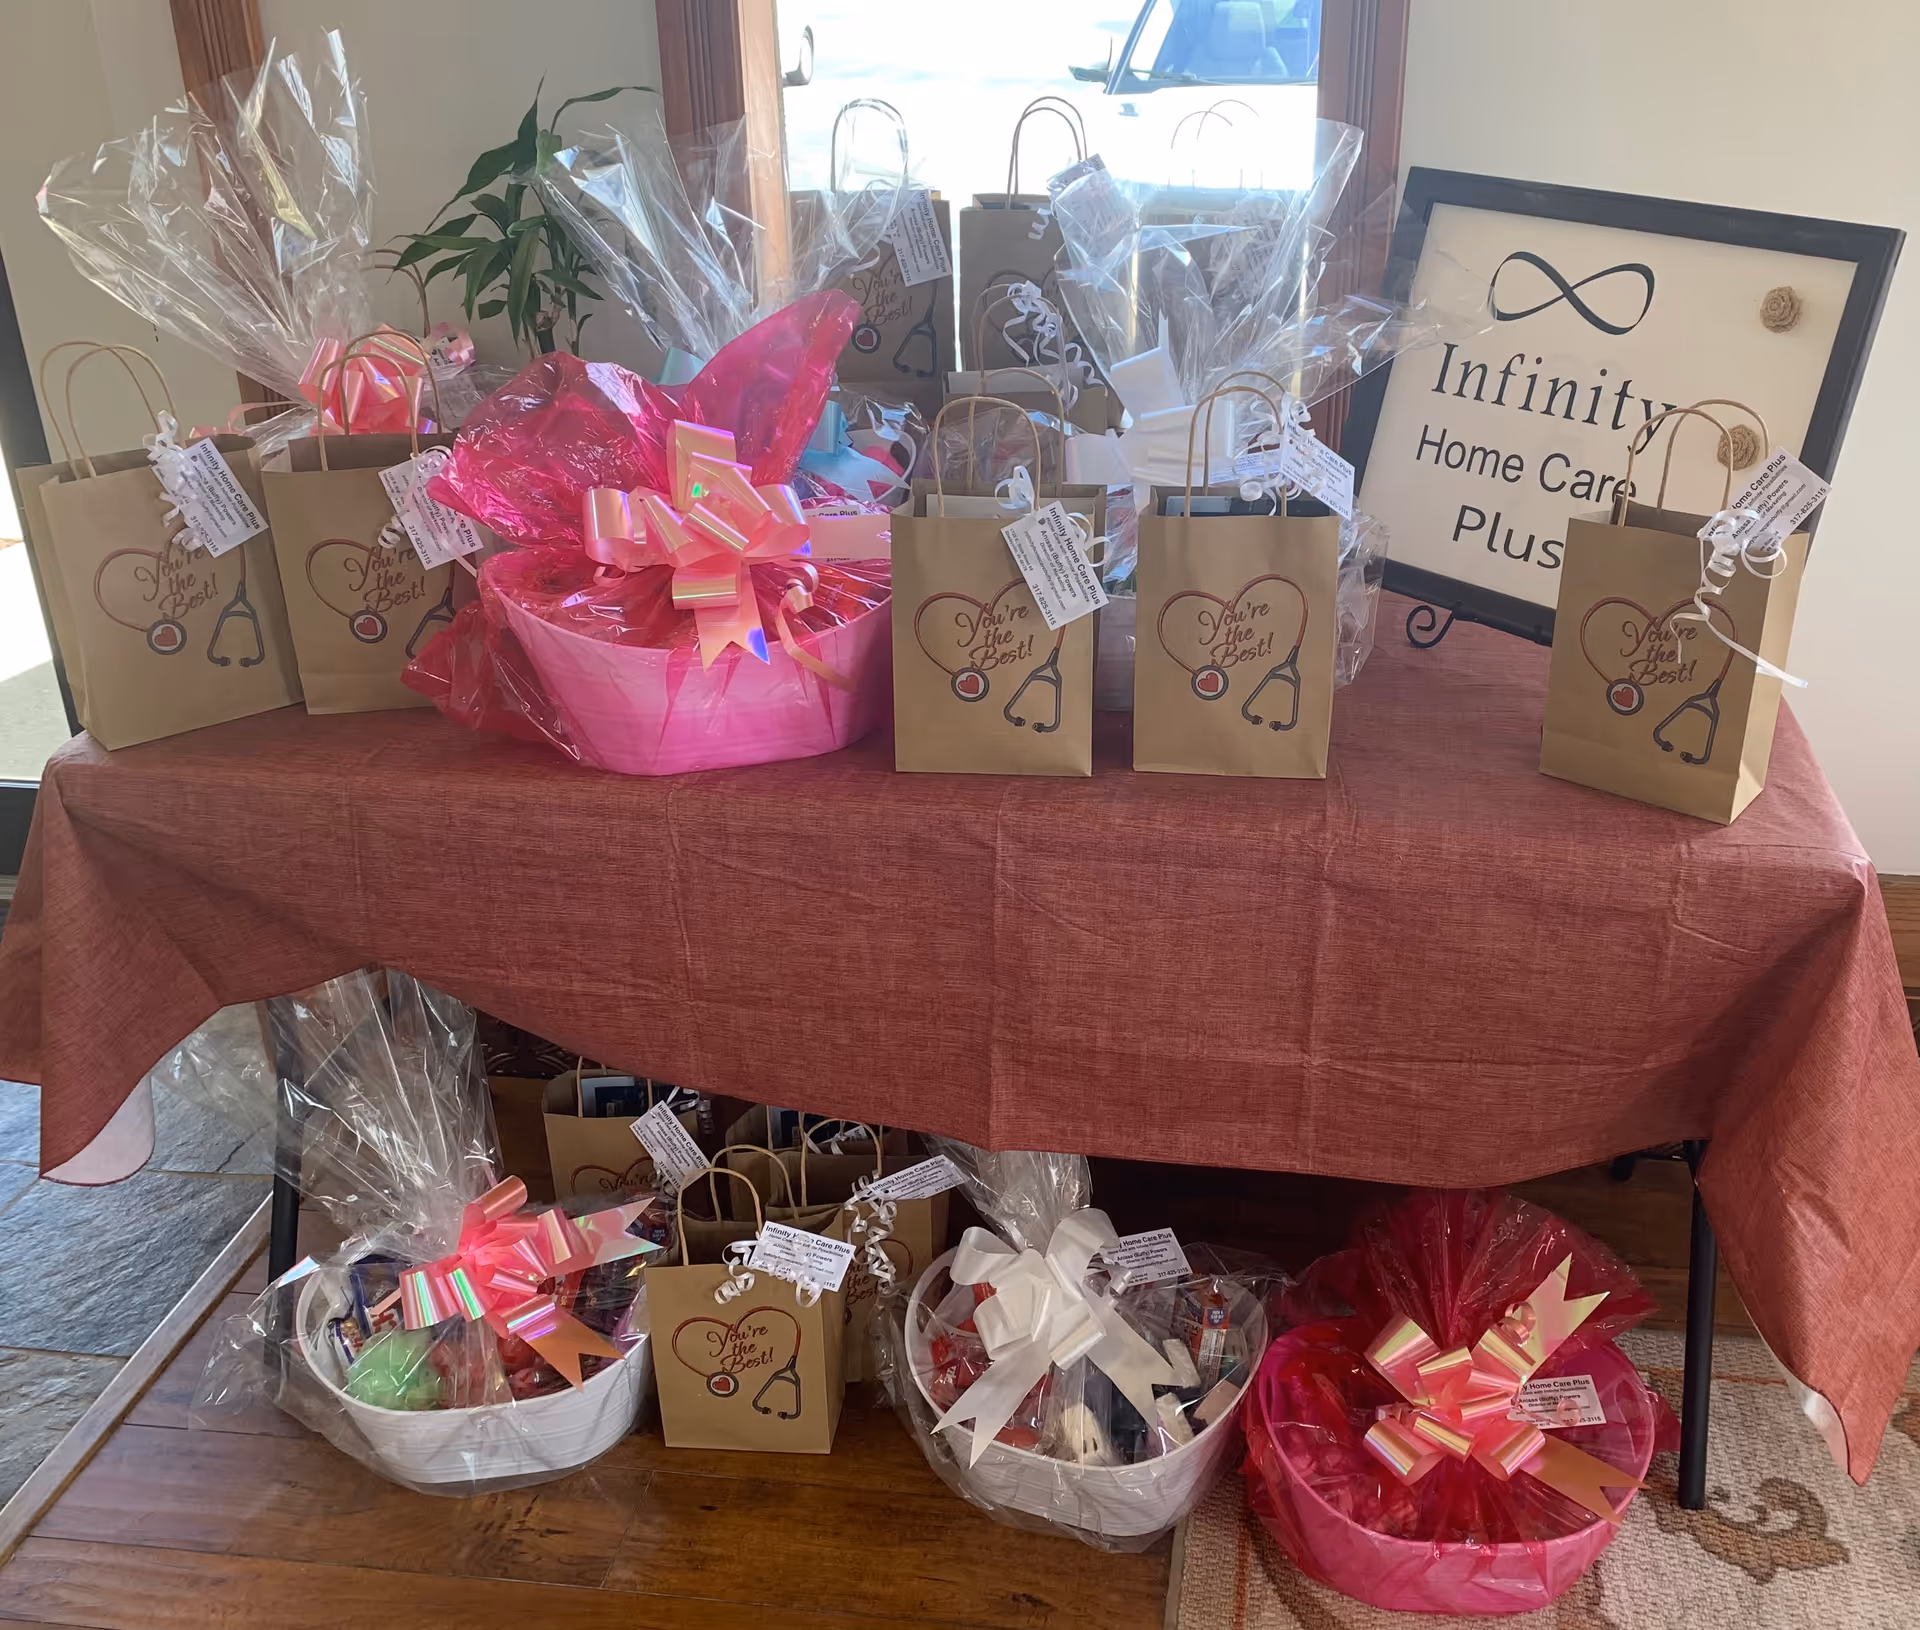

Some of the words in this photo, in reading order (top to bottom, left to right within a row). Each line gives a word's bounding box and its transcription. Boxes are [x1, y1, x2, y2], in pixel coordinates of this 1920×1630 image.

[926, 217, 937, 238] Home
[933, 239, 942, 256] Care
[938, 257, 947, 273] Plus
[1431, 342, 1677, 455] Infinity
[1416, 424, 1524, 483] Home
[1539, 453, 1636, 503] Care
[1749, 471, 1769, 491] Care
[1766, 452, 1787, 472] Plus
[198, 442, 221, 471] Infinity
[217, 470, 236, 493] Home
[233, 492, 249, 512] Care
[245, 511, 261, 530] Plus
[205, 483, 223, 505] (Buffy)
[220, 503, 237, 525] Powers
[1789, 486, 1826, 525] 317-825-3115
[1730, 518, 1751, 539] Anissa
[1766, 478, 1788, 500] Powers
[407, 524, 432, 565] 317-825-3115
[462, 528, 477, 548] Plus
[1045, 516, 1055, 532] Home
[1052, 531, 1061, 544] Care
[1453, 505, 1564, 569] Plus
[134, 548, 204, 602] You're
[1039, 541, 1052, 562] Director
[1051, 567, 1067, 592] Marketing
[1040, 529, 1055, 552] Anissa
[1050, 551, 1066, 574] (Buffy)
[1062, 573, 1078, 598] Powers
[1047, 506, 1068, 538] Infinity
[1063, 537, 1081, 564] Home
[1076, 563, 1091, 584] Care
[1086, 584, 1102, 605] Plus
[158, 572, 219, 619] Best!
[169, 572, 196, 595] the
[365, 575, 426, 612] Best!
[377, 570, 405, 589] the
[1031, 583, 1057, 625] 317-825-3115
[955, 603, 1029, 648] You're
[984, 627, 1014, 649] the
[1198, 602, 1270, 646] You're
[1225, 625, 1255, 646] the
[1620, 621, 1698, 658] You're
[968, 634, 1033, 670] Best!
[1210, 632, 1273, 668] Best!
[1647, 644, 1677, 663] the
[1628, 659, 1697, 686] Best!
[656, 1104, 675, 1125] Infinity
[672, 1124, 687, 1142] Home
[684, 1141, 698, 1156] Care
[871, 1177, 894, 1191] Infinity
[894, 1170, 914, 1181] Home
[914, 1163, 929, 1173] Care
[765, 1225, 791, 1238] Infinity
[815, 1239, 833, 1249] Care
[833, 1244, 850, 1254] Plus
[1122, 1238, 1141, 1246] Home
[707, 1324, 768, 1357] You're
[732, 1342, 759, 1358] the
[720, 1347, 773, 1374] Best!
